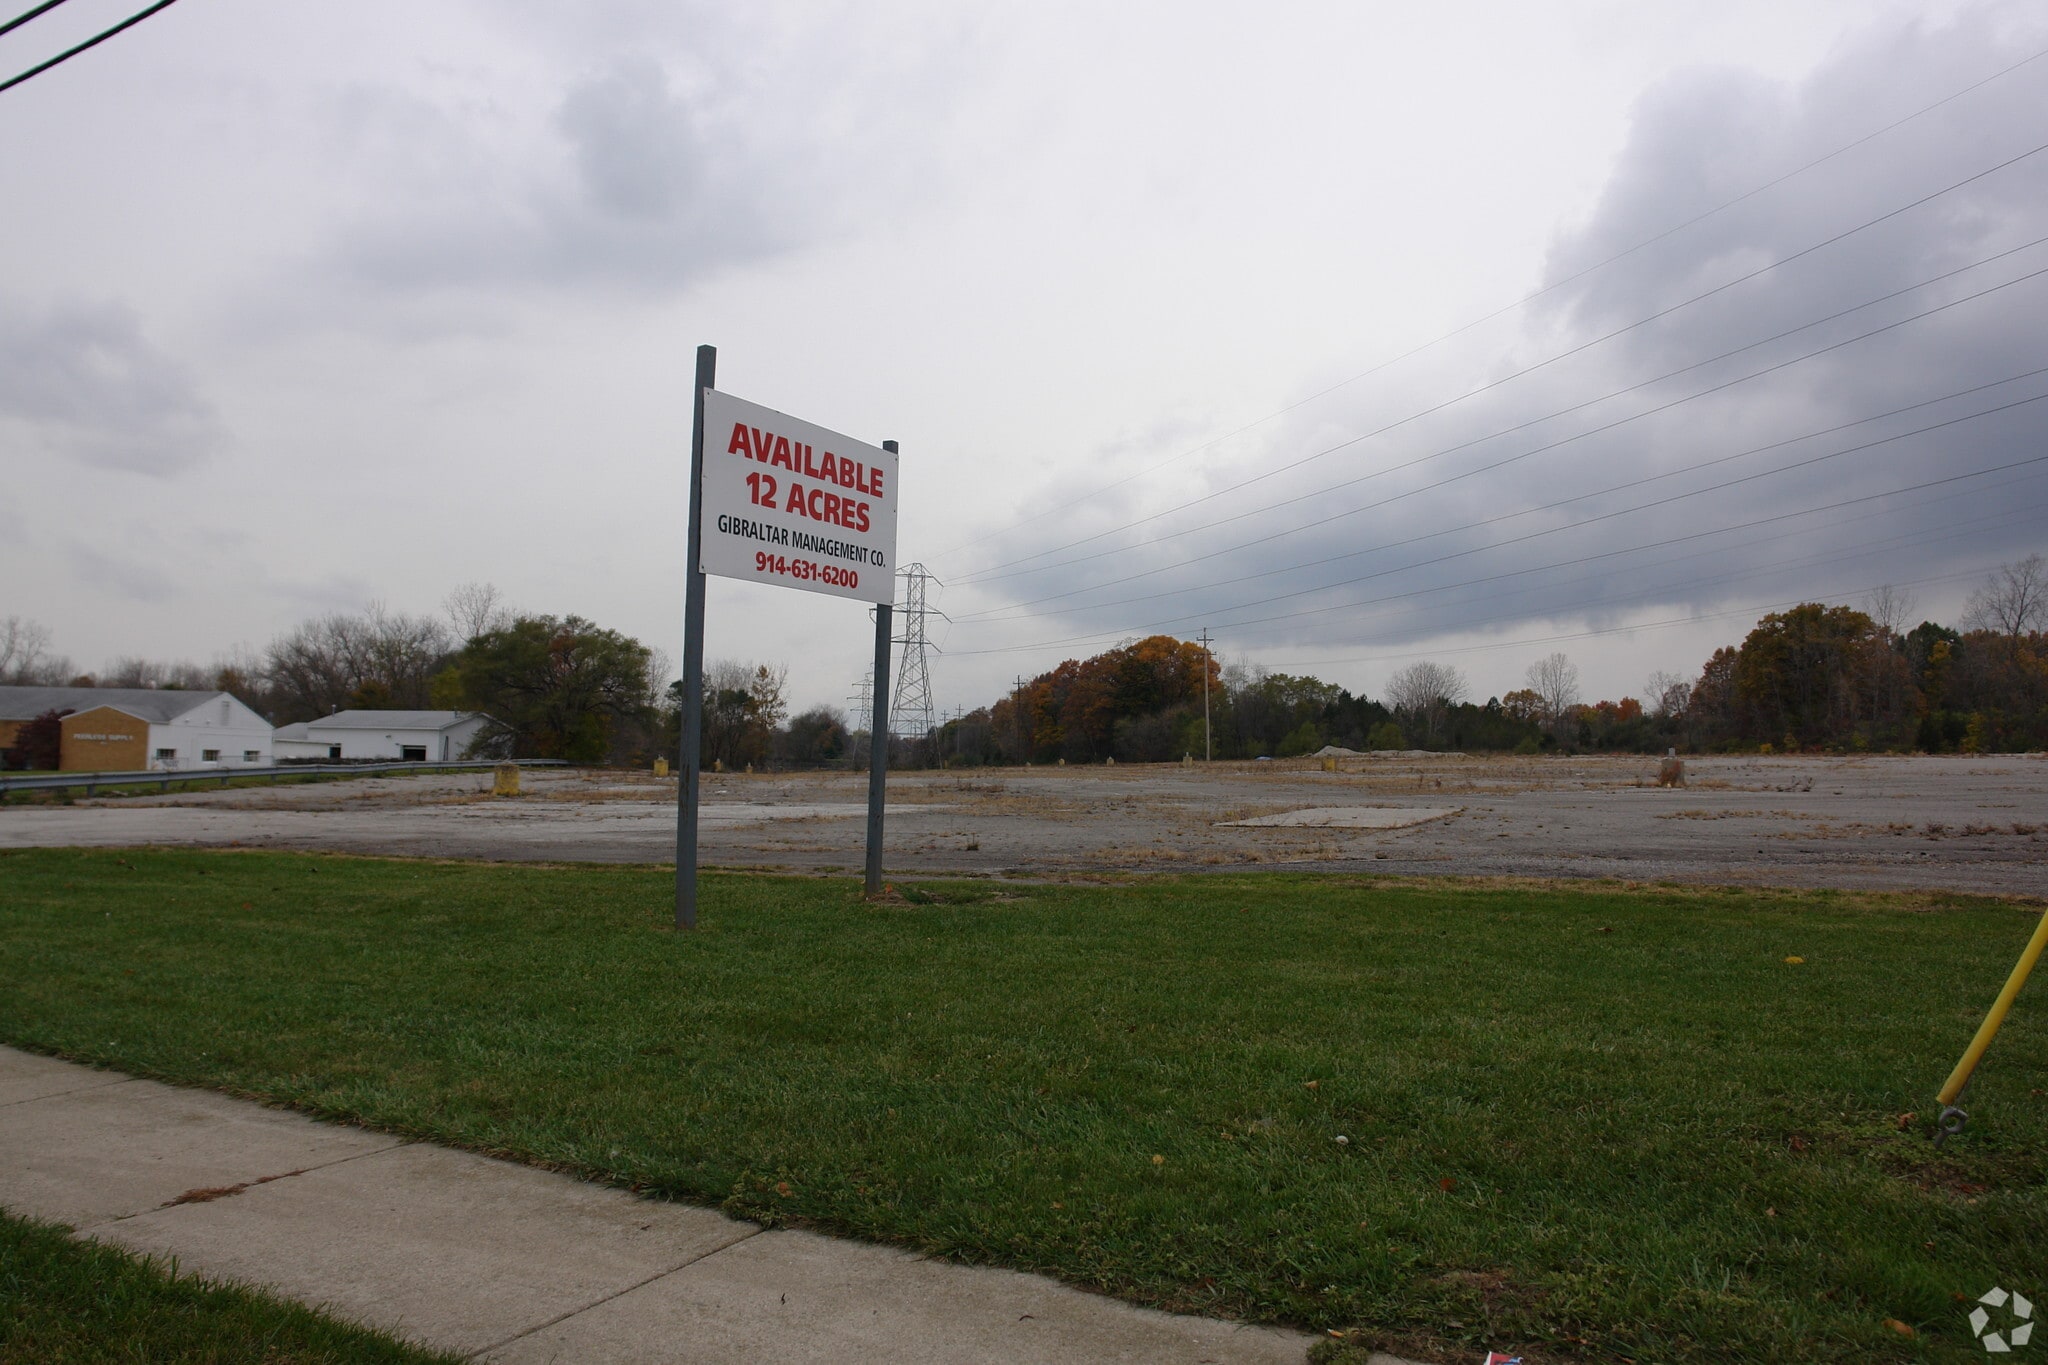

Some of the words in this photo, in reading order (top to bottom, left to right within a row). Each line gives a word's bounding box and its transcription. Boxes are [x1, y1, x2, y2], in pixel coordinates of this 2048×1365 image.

[728, 422, 883, 498] AVAILABLE
[746, 472, 777, 509] 12
[786, 483, 869, 532] ACRES
[718, 514, 788, 546] GIBRALTAR
[792, 532, 868, 563] MANAGEMENT
[870, 550, 886, 567] CO.
[755, 551, 858, 588] 914-631-6200
